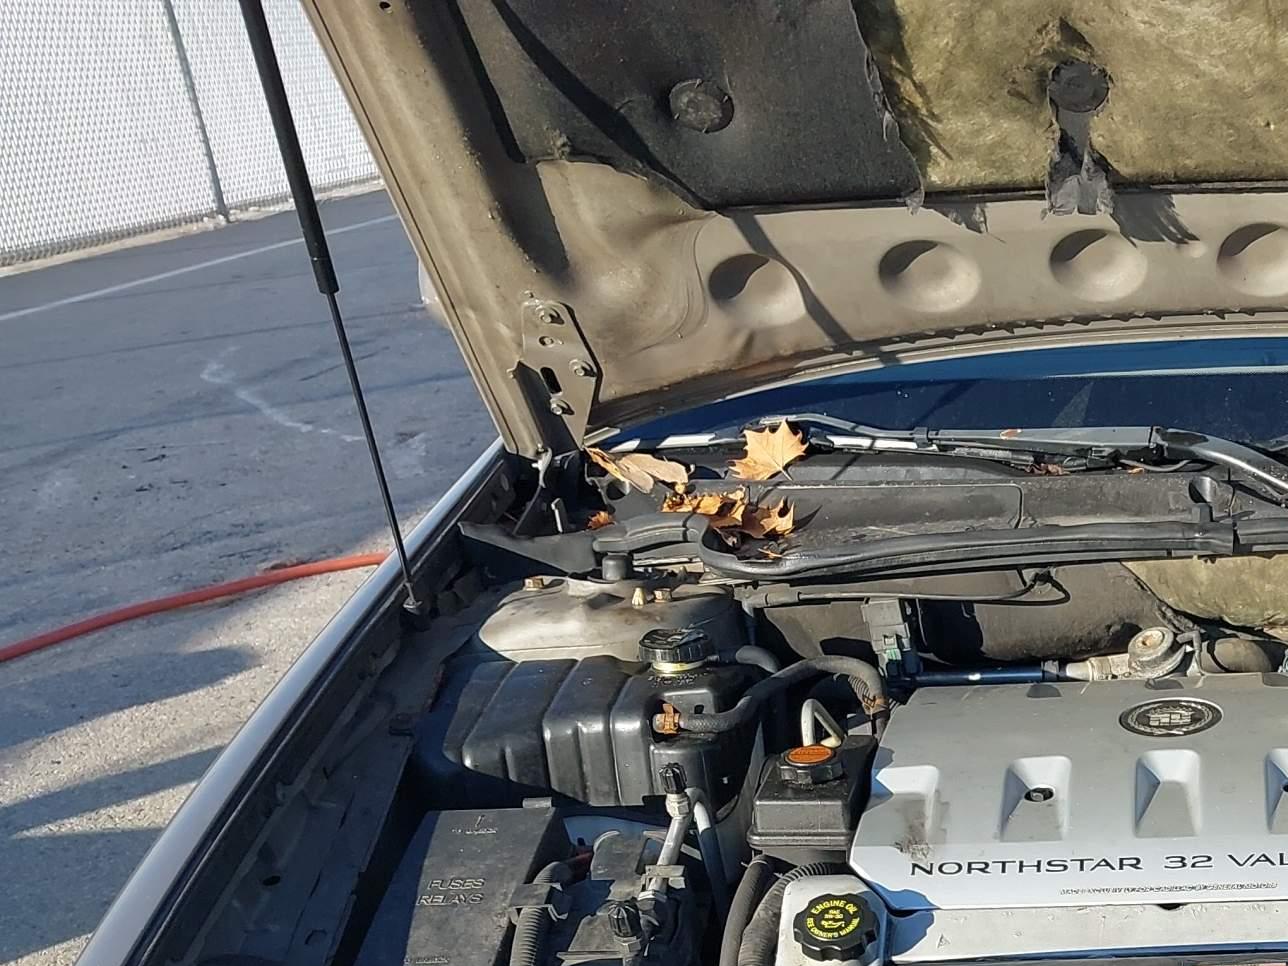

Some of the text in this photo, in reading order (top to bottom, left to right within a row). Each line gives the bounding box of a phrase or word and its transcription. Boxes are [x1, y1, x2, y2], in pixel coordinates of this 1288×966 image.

[910, 857, 1143, 876] NORTHSTAR
[1164, 855, 1213, 869] 32
[427, 878, 485, 890] FUSES
[415, 893, 485, 906] RELAYS
[810, 900, 858, 915] ENGINE OIL
